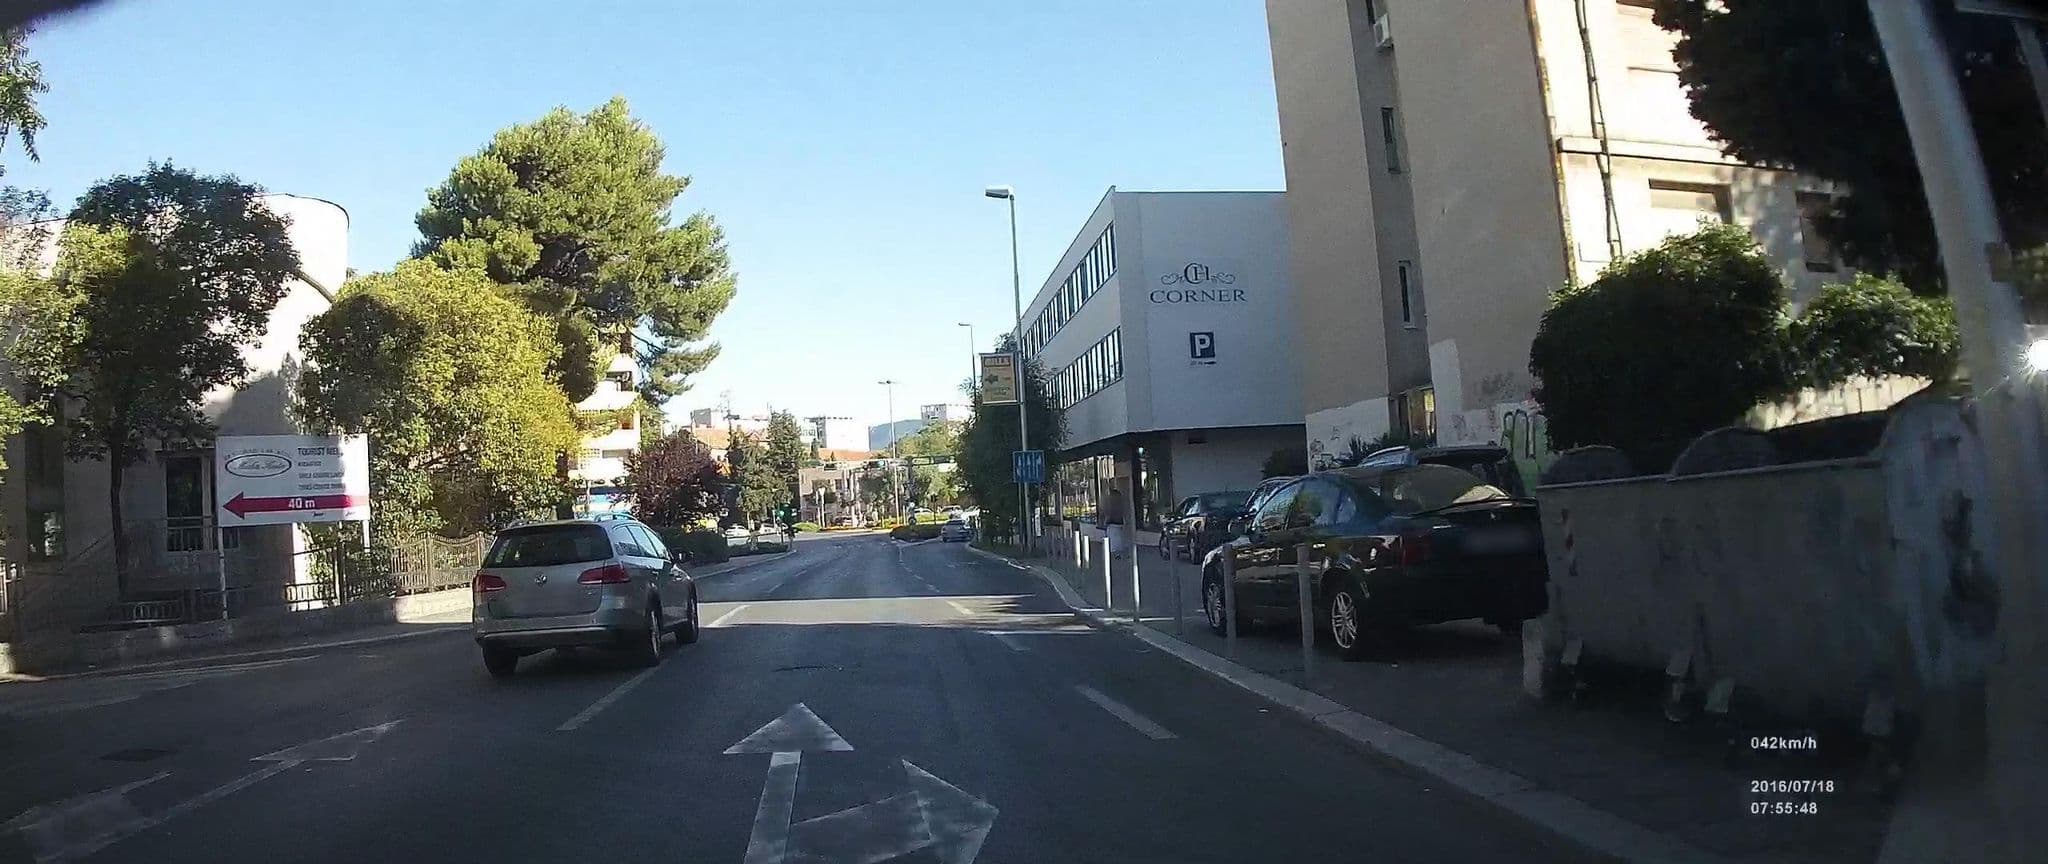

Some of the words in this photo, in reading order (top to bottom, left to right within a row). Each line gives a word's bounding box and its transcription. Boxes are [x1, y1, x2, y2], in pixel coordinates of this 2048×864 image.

[1149, 289, 1248, 304] CORNER
[1195, 335, 1210, 357] P
[298, 447, 325, 456] TOURIST
[288, 498, 303, 509] 40
[305, 499, 316, 508] m
